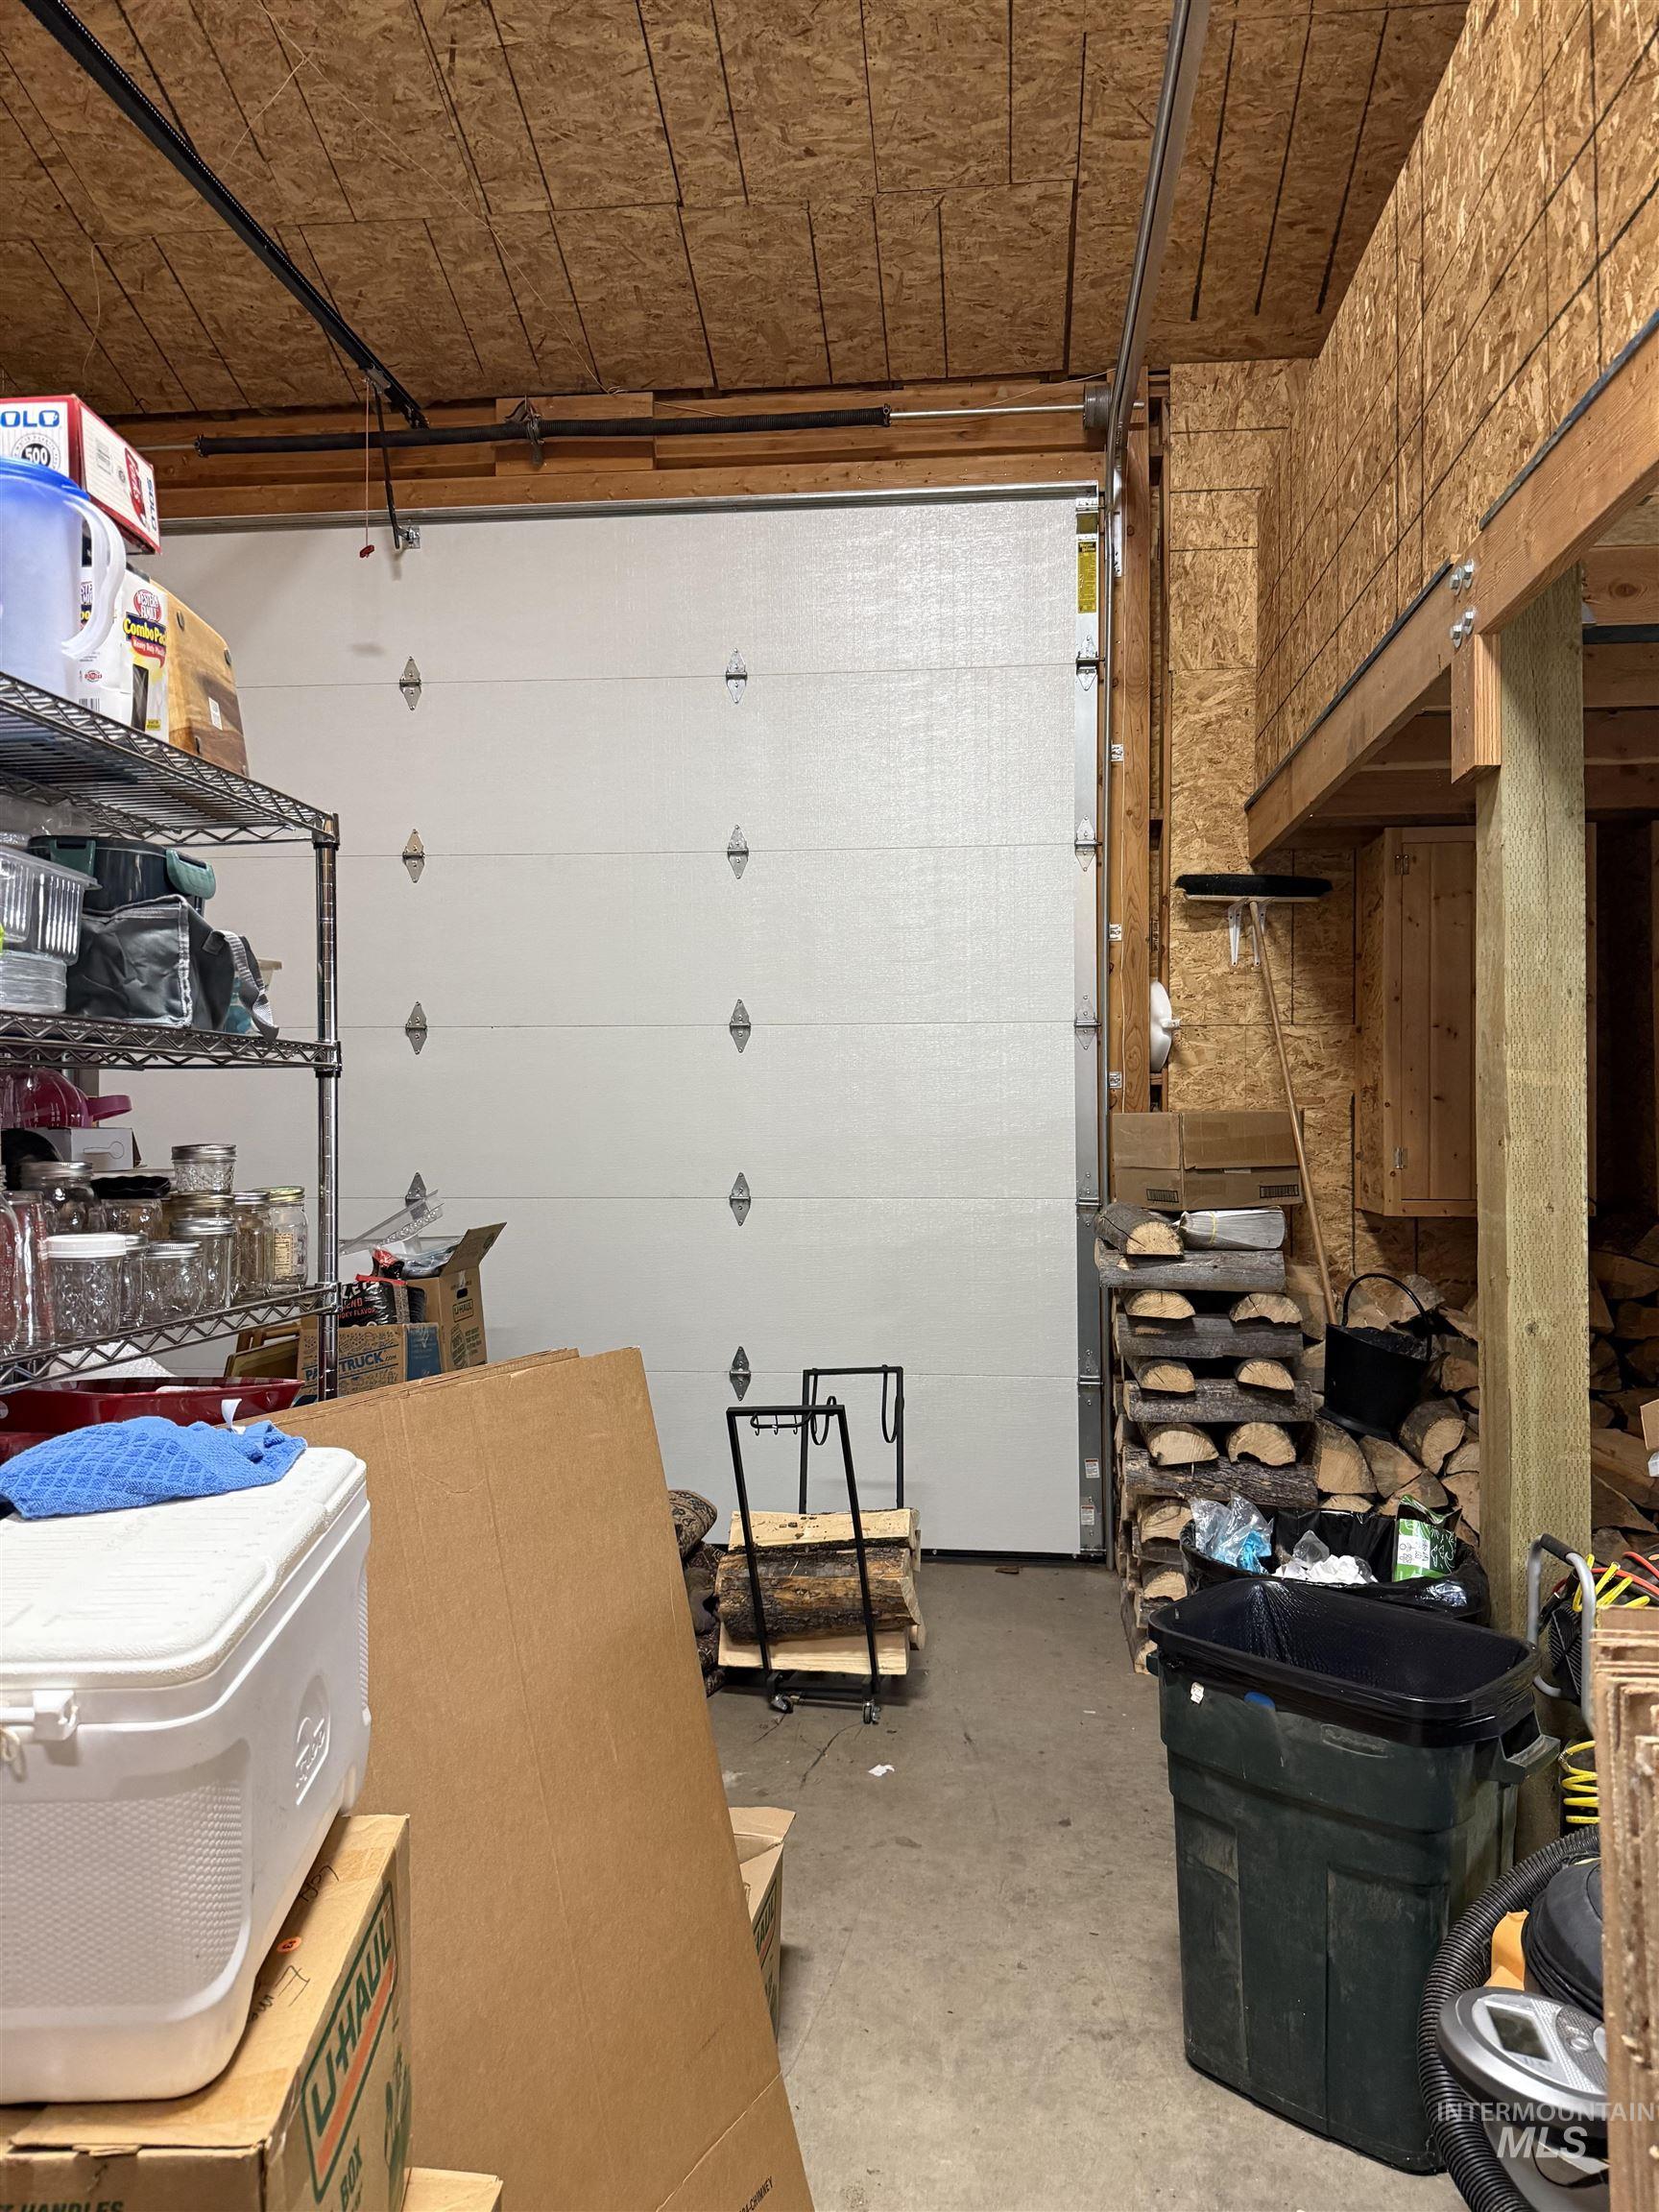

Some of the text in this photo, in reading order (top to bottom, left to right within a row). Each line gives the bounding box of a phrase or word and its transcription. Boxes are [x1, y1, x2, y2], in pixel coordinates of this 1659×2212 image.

[25, 446, 48, 465] 500
[147, 476, 157, 532] SOLO
[123, 617, 154, 641] Combo
[311, 1917, 391, 2137] U-HAUL
[340, 2135, 364, 2212] BOX
